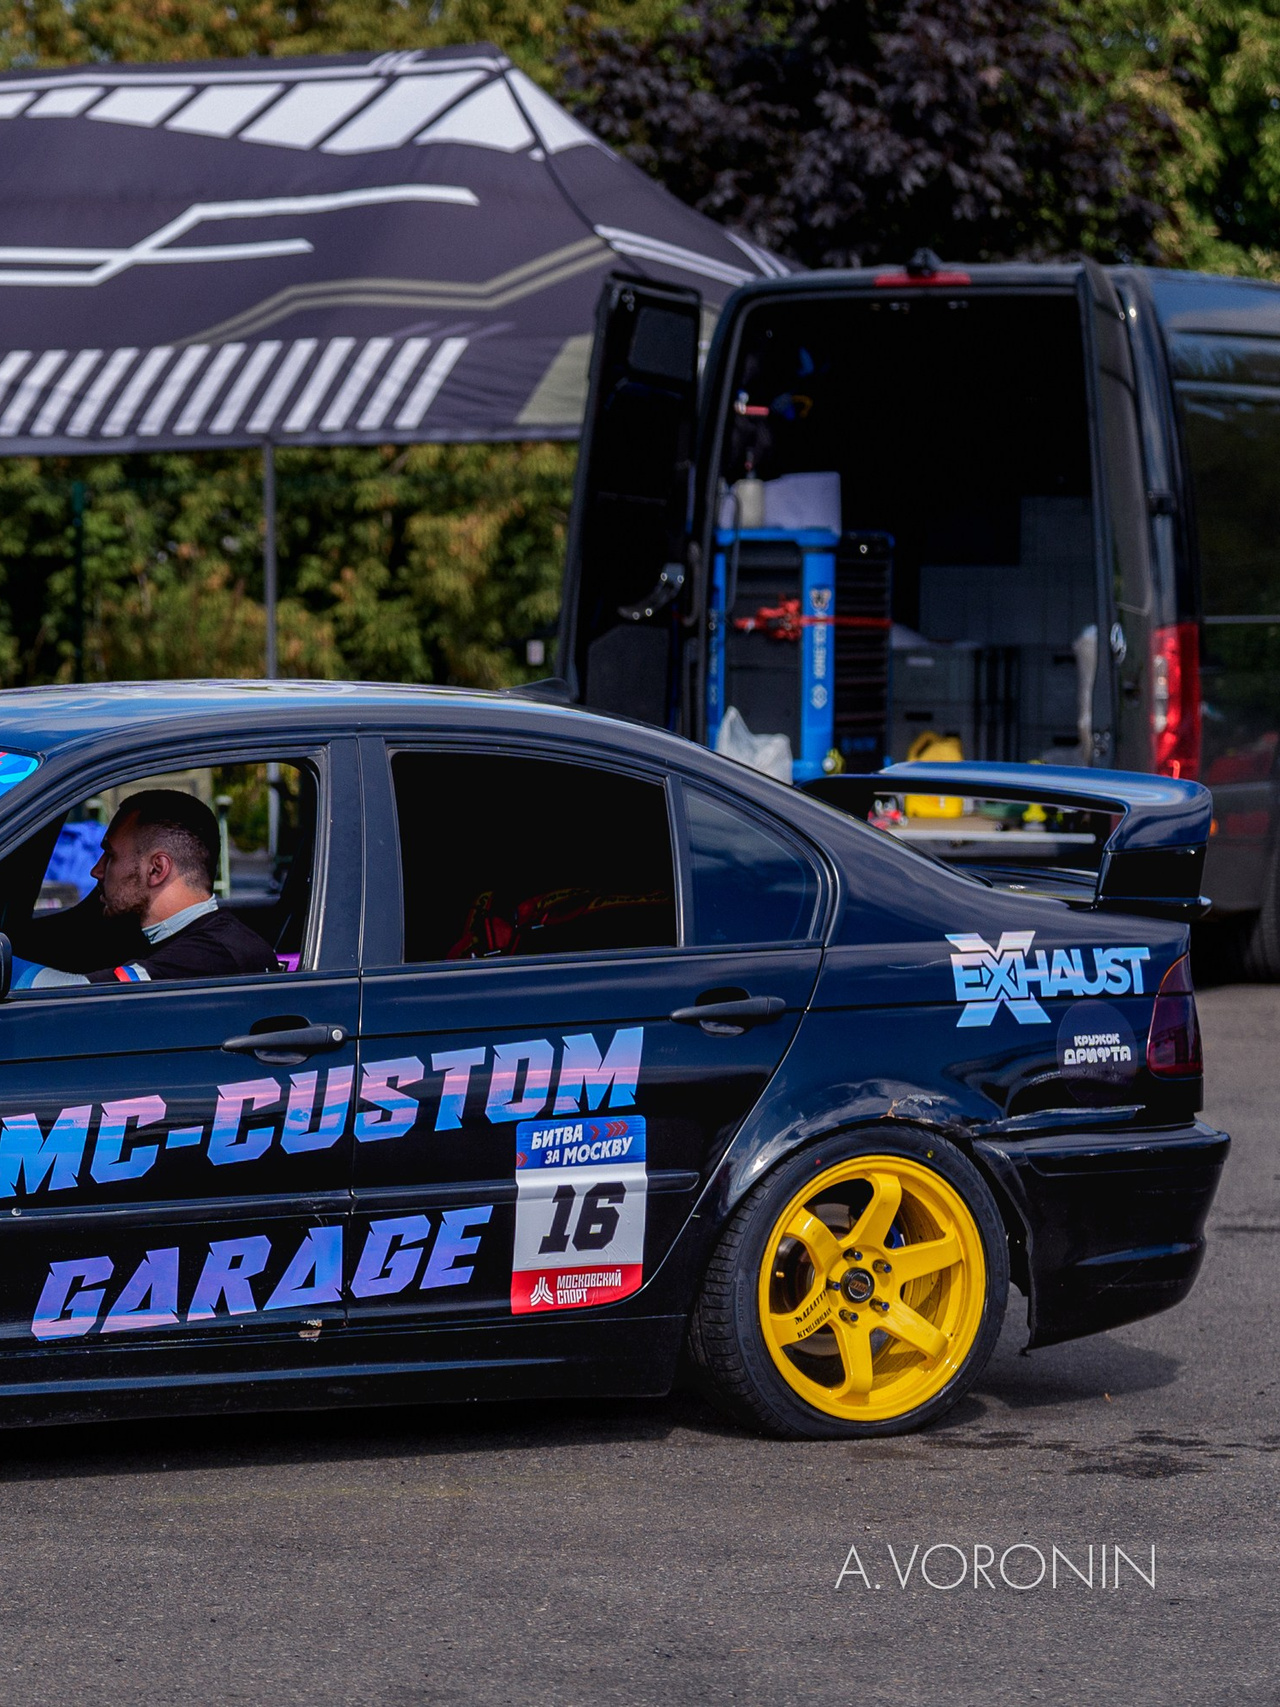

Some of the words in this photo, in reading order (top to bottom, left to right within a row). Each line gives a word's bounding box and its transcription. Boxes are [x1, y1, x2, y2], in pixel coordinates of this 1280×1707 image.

[945, 931, 1151, 1027] EXHAUST
[531, 1124, 583, 1150] БИТВА
[545, 1149, 560, 1165] ЗА
[562, 1137, 634, 1165] МОСКВУ
[538, 1181, 628, 1255] 16
[31, 1205, 494, 1341] GARAGE
[556, 1269, 622, 1289] МОСКОВСКИЙ
[557, 1289, 588, 1305] СПОРТ
